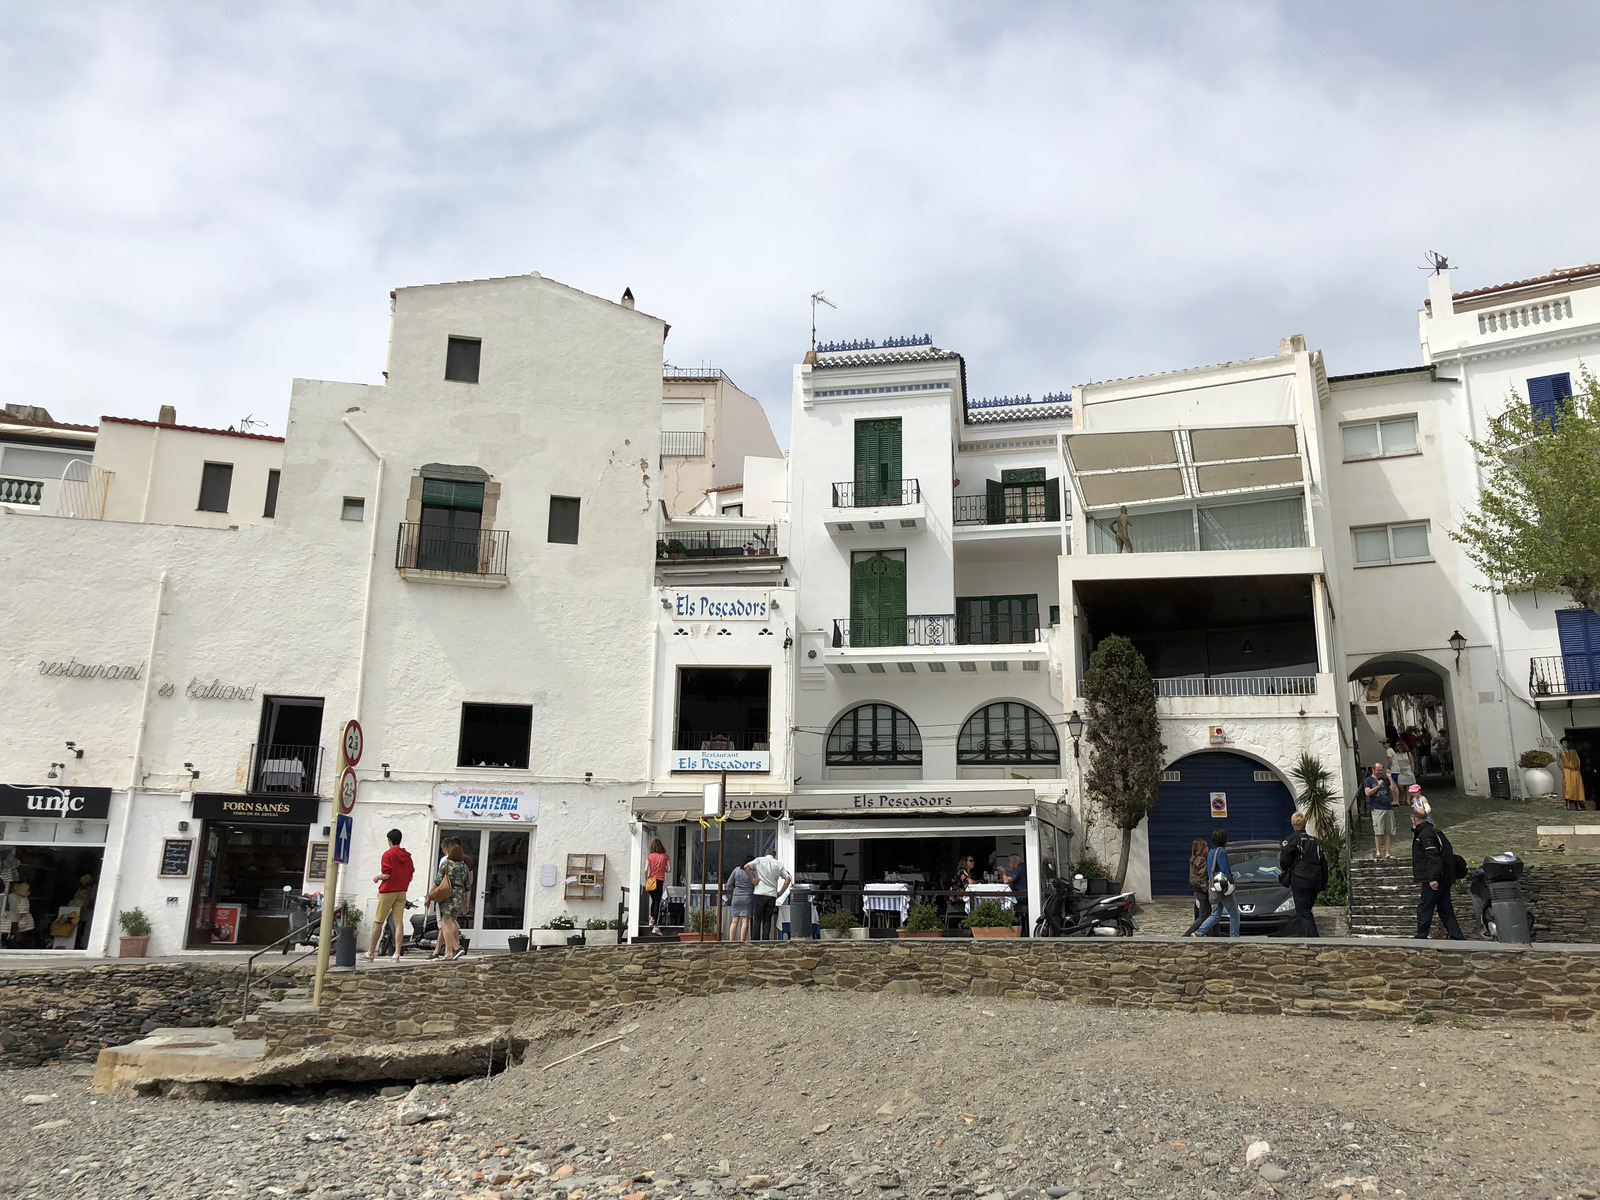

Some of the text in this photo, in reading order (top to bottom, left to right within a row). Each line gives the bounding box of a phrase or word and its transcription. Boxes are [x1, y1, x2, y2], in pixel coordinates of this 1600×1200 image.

[676, 594, 766, 617] Els Pescadors
[38, 656, 146, 681] restaurant
[158, 682, 175, 697] es
[678, 756, 762, 769] Els Pescadors
[223, 801, 290, 813] FORN SANÉS
[457, 795, 519, 811] PEIXATERIA
[853, 794, 952, 808] Els Pescadors
